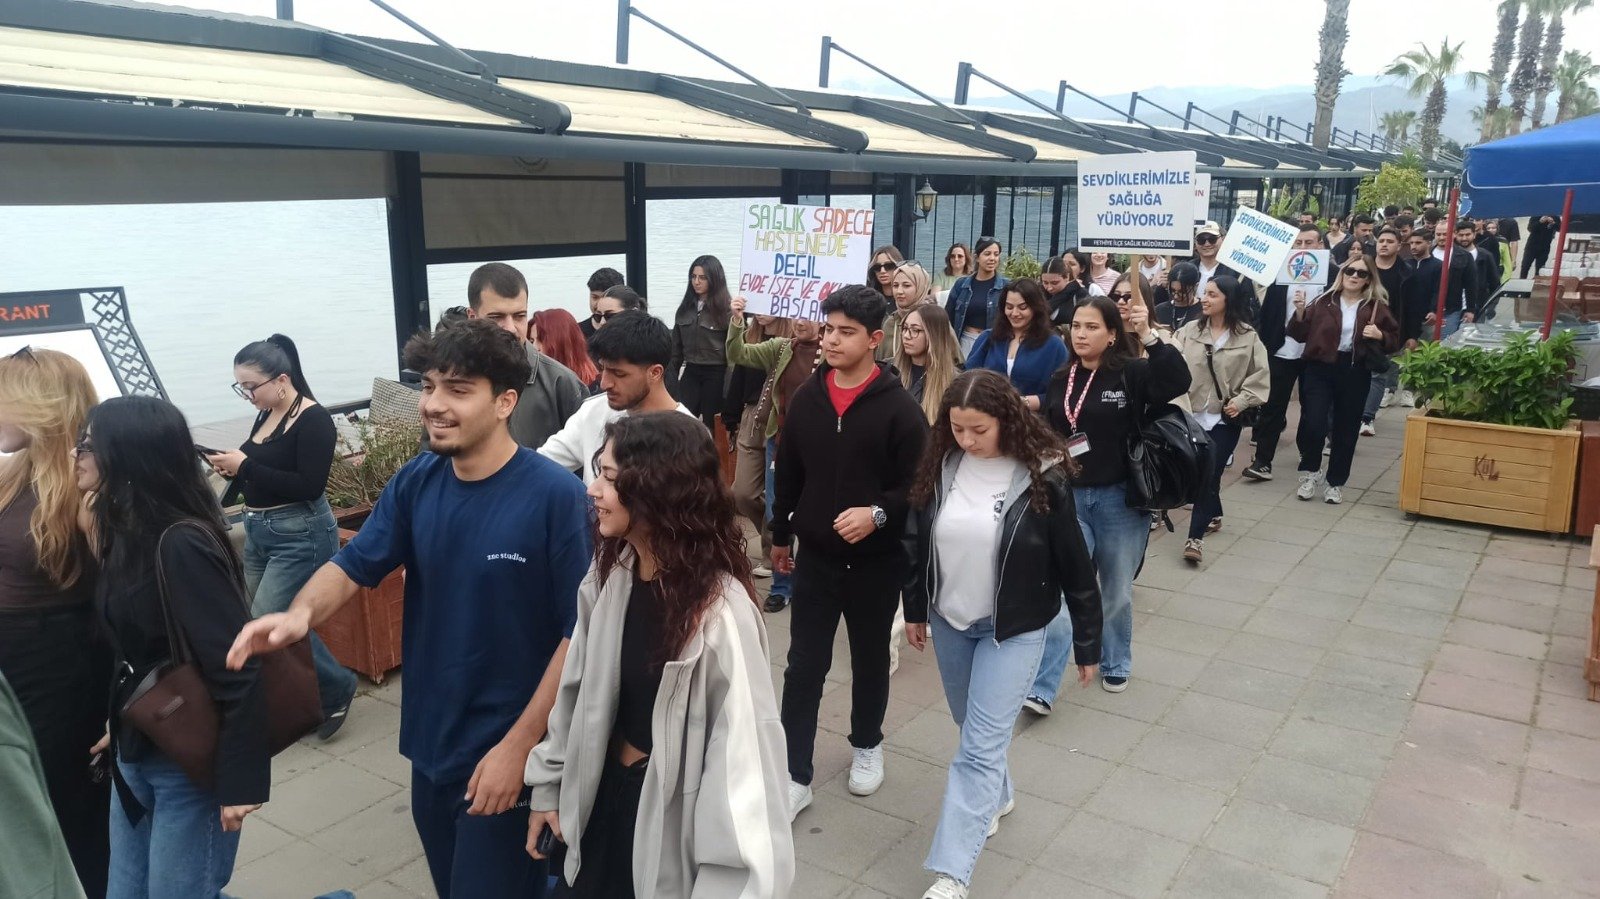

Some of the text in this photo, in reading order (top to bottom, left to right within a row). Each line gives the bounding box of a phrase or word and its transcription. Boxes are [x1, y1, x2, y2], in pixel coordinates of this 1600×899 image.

[1082, 168, 1190, 187] SEVDİKLERİMİZLE
[1108, 190, 1162, 206] SAĞLIĞA
[812, 208, 875, 235] SADECE
[1097, 211, 1174, 226] YÜRÜYORUZ
[1237, 212, 1294, 244] SEVDİKLERİMİZLE
[755, 230, 850, 257] HASTENEDE
[1124, 239, 1141, 247] SAĞLIK
[1141, 240, 1176, 248] MÜDÜRLÜĞÜ
[1242, 235, 1270, 255] SAĞLIĞA
[1230, 249, 1267, 274] YÜRÜYORUZ
[739, 273, 770, 294] EVDE
[799, 279, 820, 299] VE
